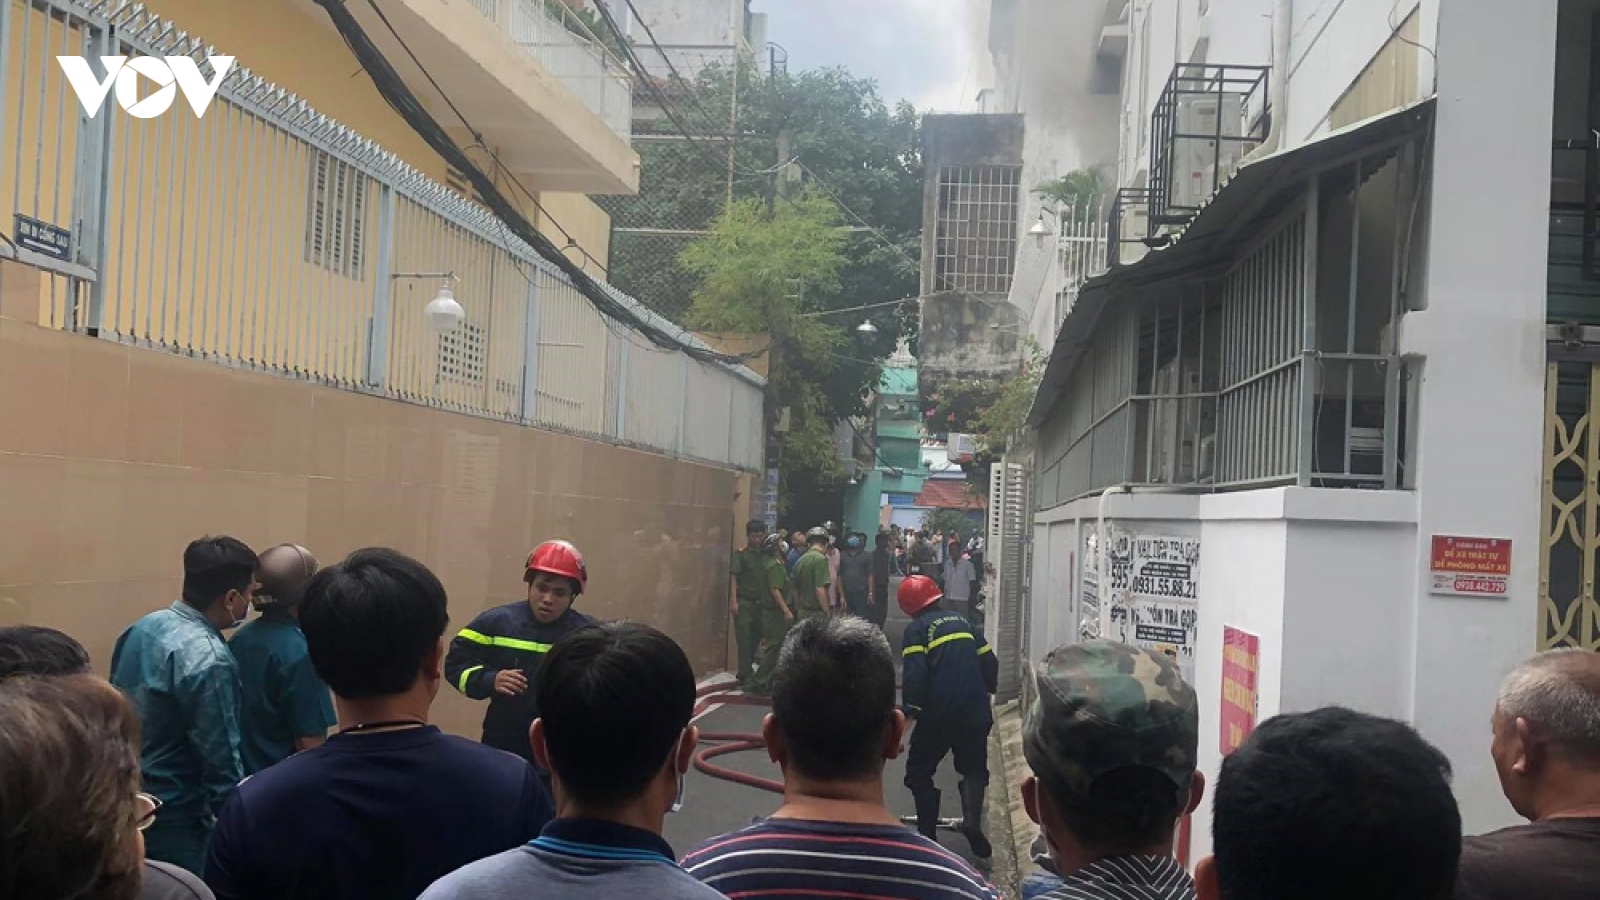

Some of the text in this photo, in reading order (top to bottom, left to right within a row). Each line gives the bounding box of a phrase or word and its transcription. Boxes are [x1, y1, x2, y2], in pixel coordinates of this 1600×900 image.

[1456, 550, 1467, 558] XE
[1496, 563, 1507, 571] XE
[1132, 576, 1197, 599] 0931.55.88.21
